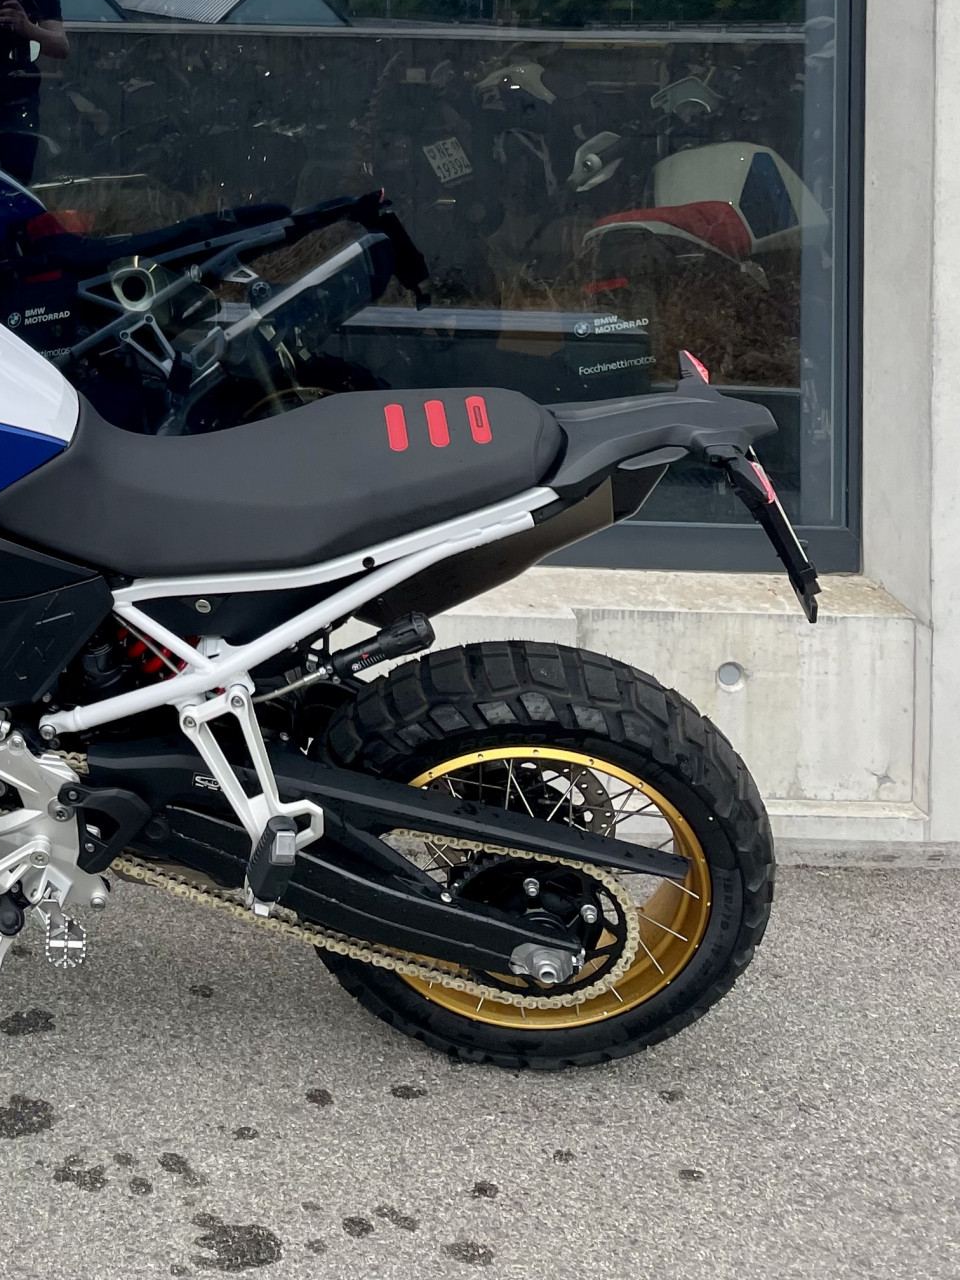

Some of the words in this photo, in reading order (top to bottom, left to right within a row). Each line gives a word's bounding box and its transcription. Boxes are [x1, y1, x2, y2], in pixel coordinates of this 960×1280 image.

[24, 307, 46, 317] BMW
[24, 310, 71, 326] MOTORRAD
[593, 315, 618, 326] BMW
[594, 318, 650, 334] MOTORRAD
